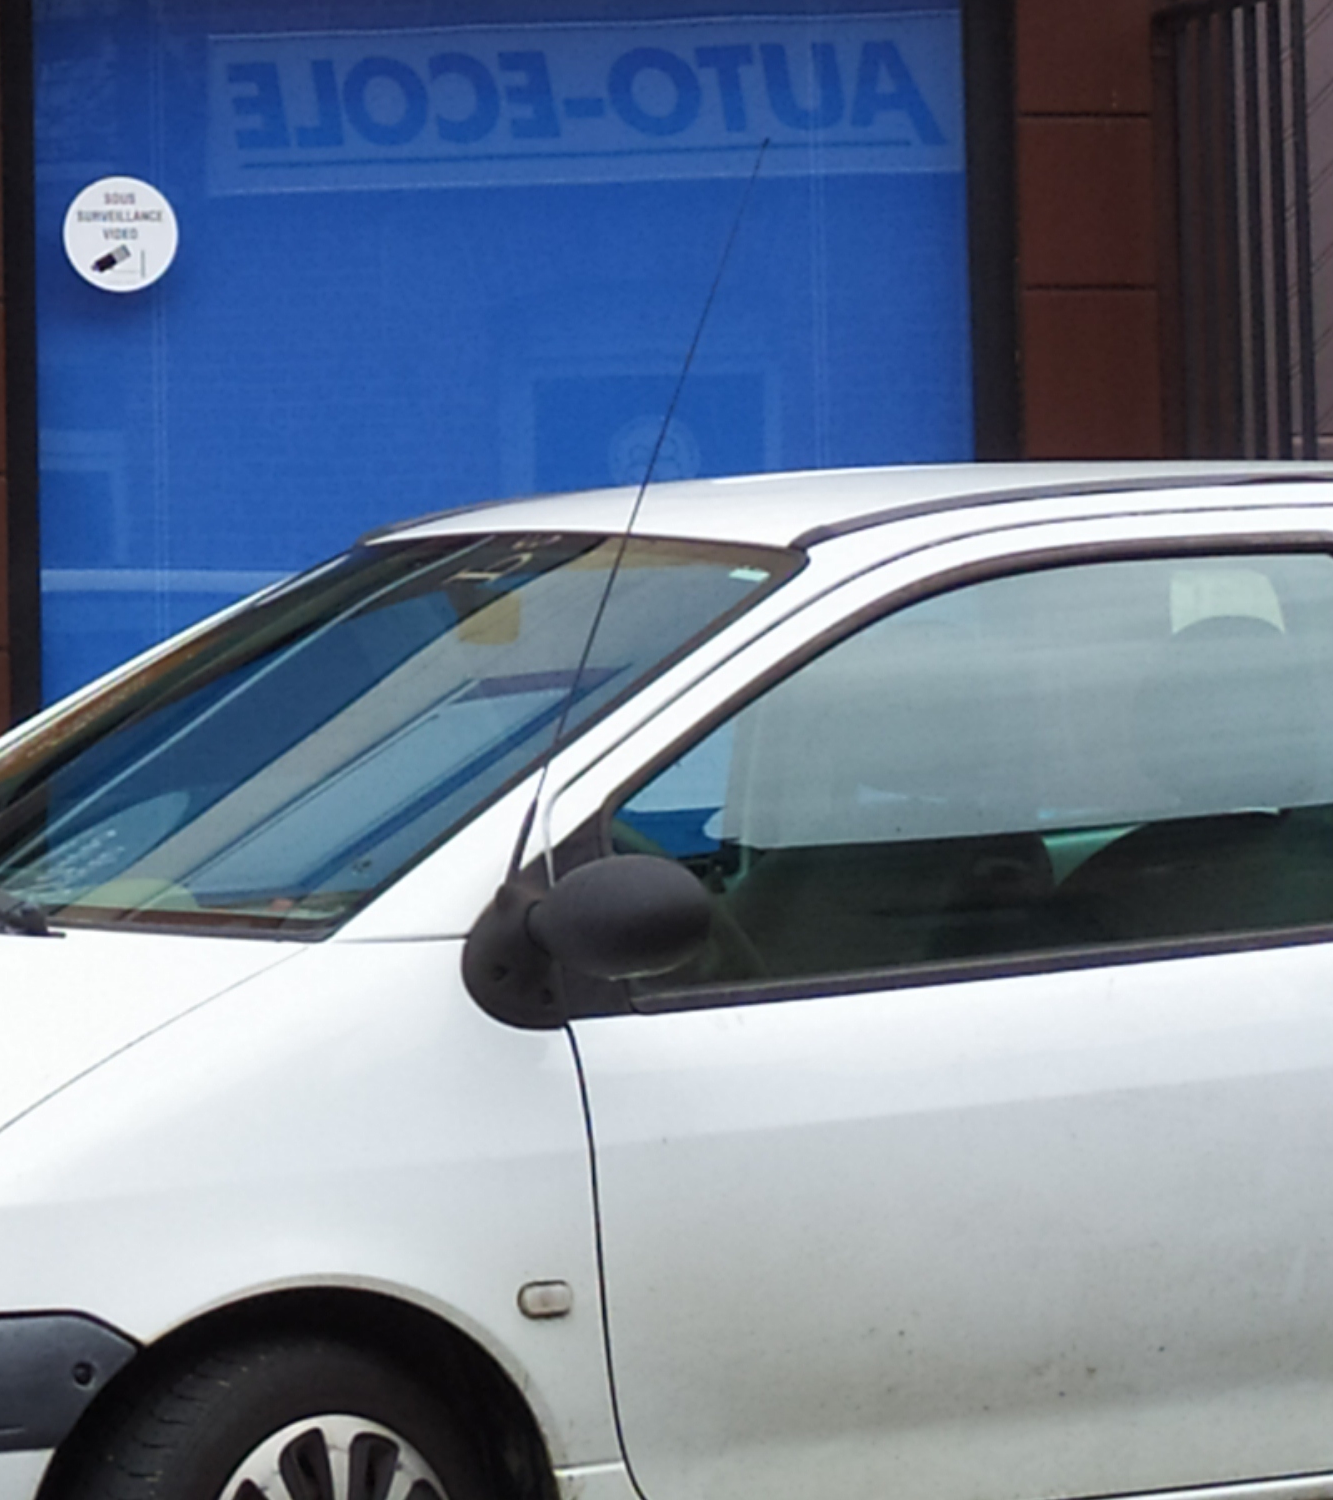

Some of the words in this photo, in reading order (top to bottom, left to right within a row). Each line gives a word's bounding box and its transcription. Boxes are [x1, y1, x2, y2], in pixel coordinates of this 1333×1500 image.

[104, 192, 135, 205] SOUS
[77, 210, 163, 223] SURVEILLANCE
[102, 227, 138, 240] VIDEO
